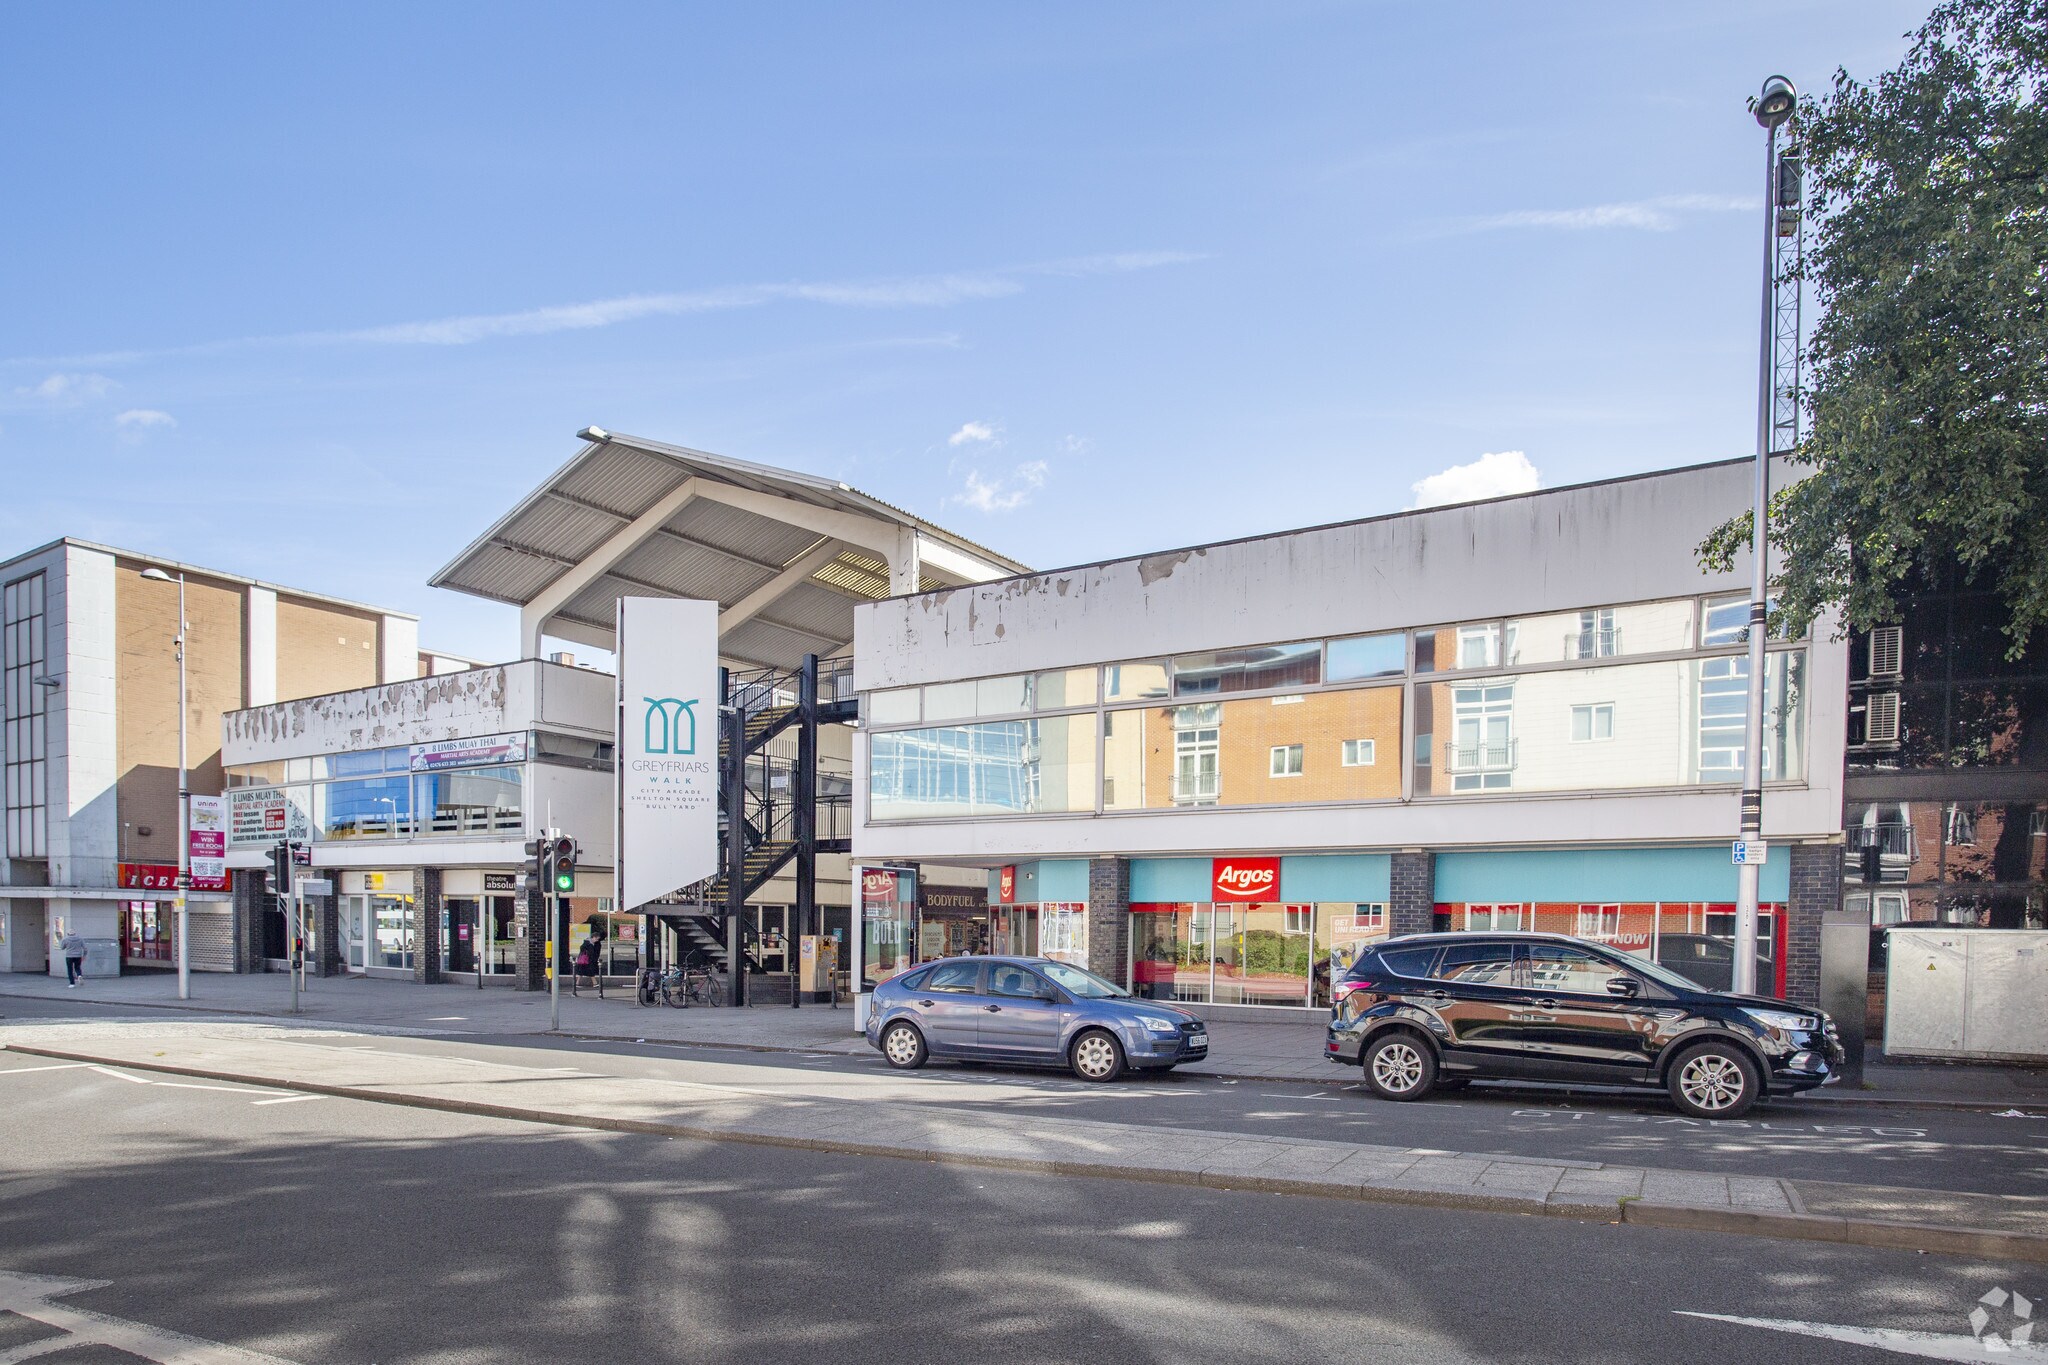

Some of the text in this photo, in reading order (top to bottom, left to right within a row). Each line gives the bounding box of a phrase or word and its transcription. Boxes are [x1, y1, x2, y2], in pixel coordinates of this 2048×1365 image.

[437, 742, 458, 752] LIMBS
[460, 740, 477, 749] MUAY
[480, 737, 497, 746] THAI
[632, 760, 709, 773] GREYFRIARS
[650, 776, 692, 784] WALK
[233, 794, 238, 802] 8
[238, 792, 254, 802] LIMBS
[255, 791, 272, 800] MUAY
[233, 800, 286, 810] MARTIAL ARTS ACADEMY
[130, 874, 223, 889] ICEL
[1217, 865, 1274, 888] Argos
[927, 894, 975, 907] BODYFUEL
[1614, 933, 1647, 944] NOW
[1510, 1109, 1928, 1137] DISABLED
